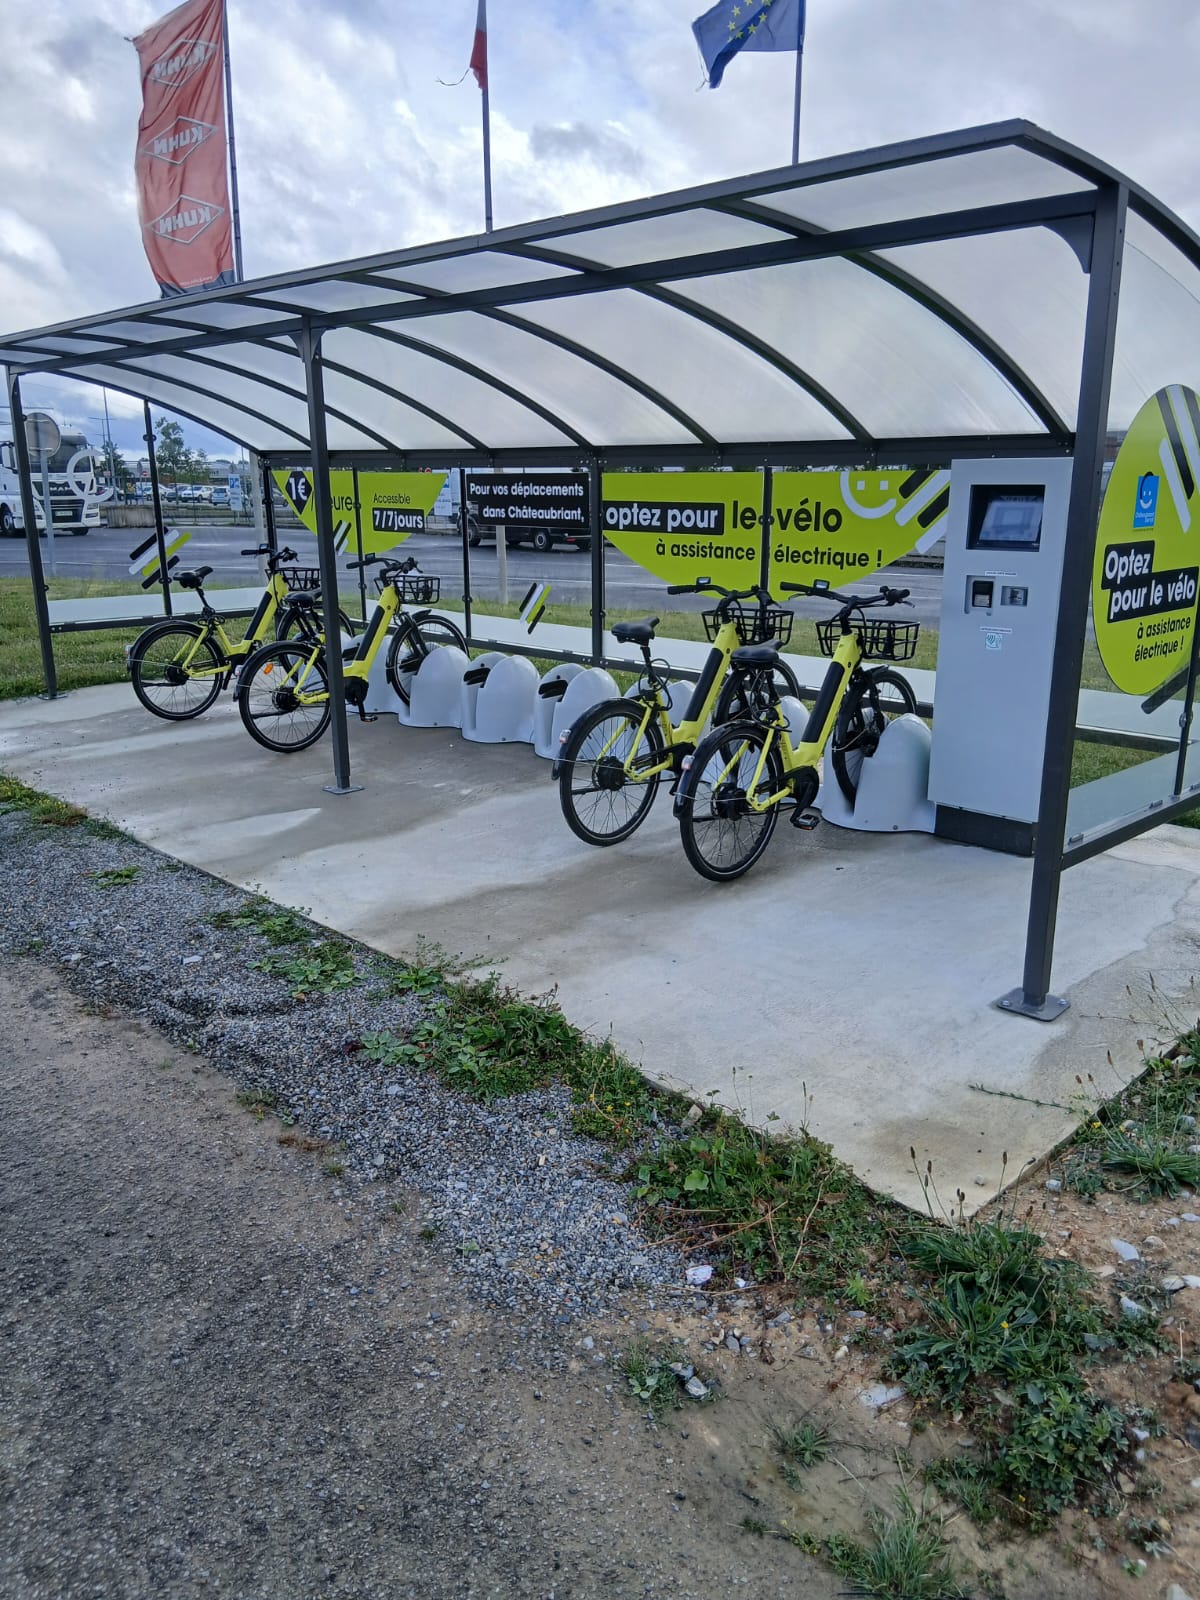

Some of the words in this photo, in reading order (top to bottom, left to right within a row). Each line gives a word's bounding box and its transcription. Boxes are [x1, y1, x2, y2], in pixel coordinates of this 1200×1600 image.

[289, 477, 307, 501] 1€
[373, 492, 411, 504] Accessible
[470, 483, 490, 495] Pour
[492, 487, 508, 496] vos
[511, 482, 584, 498] déplacements
[373, 510, 424, 531] 7/7jours
[482, 505, 506, 518] dans
[508, 505, 585, 523] Châteaubriant,
[605, 503, 661, 530] optez
[667, 508, 718, 532] pour
[732, 500, 757, 530] le
[776, 497, 843, 533] vélo
[656, 538, 666, 556] à
[670, 541, 756, 561] assistance
[774, 544, 870, 570] électrique
[876, 549, 882, 568] !
[1105, 548, 1151, 585] Optez
[1109, 586, 1148, 620] pour
[1149, 579, 1163, 606] le
[1167, 572, 1196, 602] vélo
[1137, 622, 1144, 640] à
[1146, 616, 1191, 637] assistance
[1134, 639, 1179, 662] électrique
[1180, 635, 1185, 651] !
